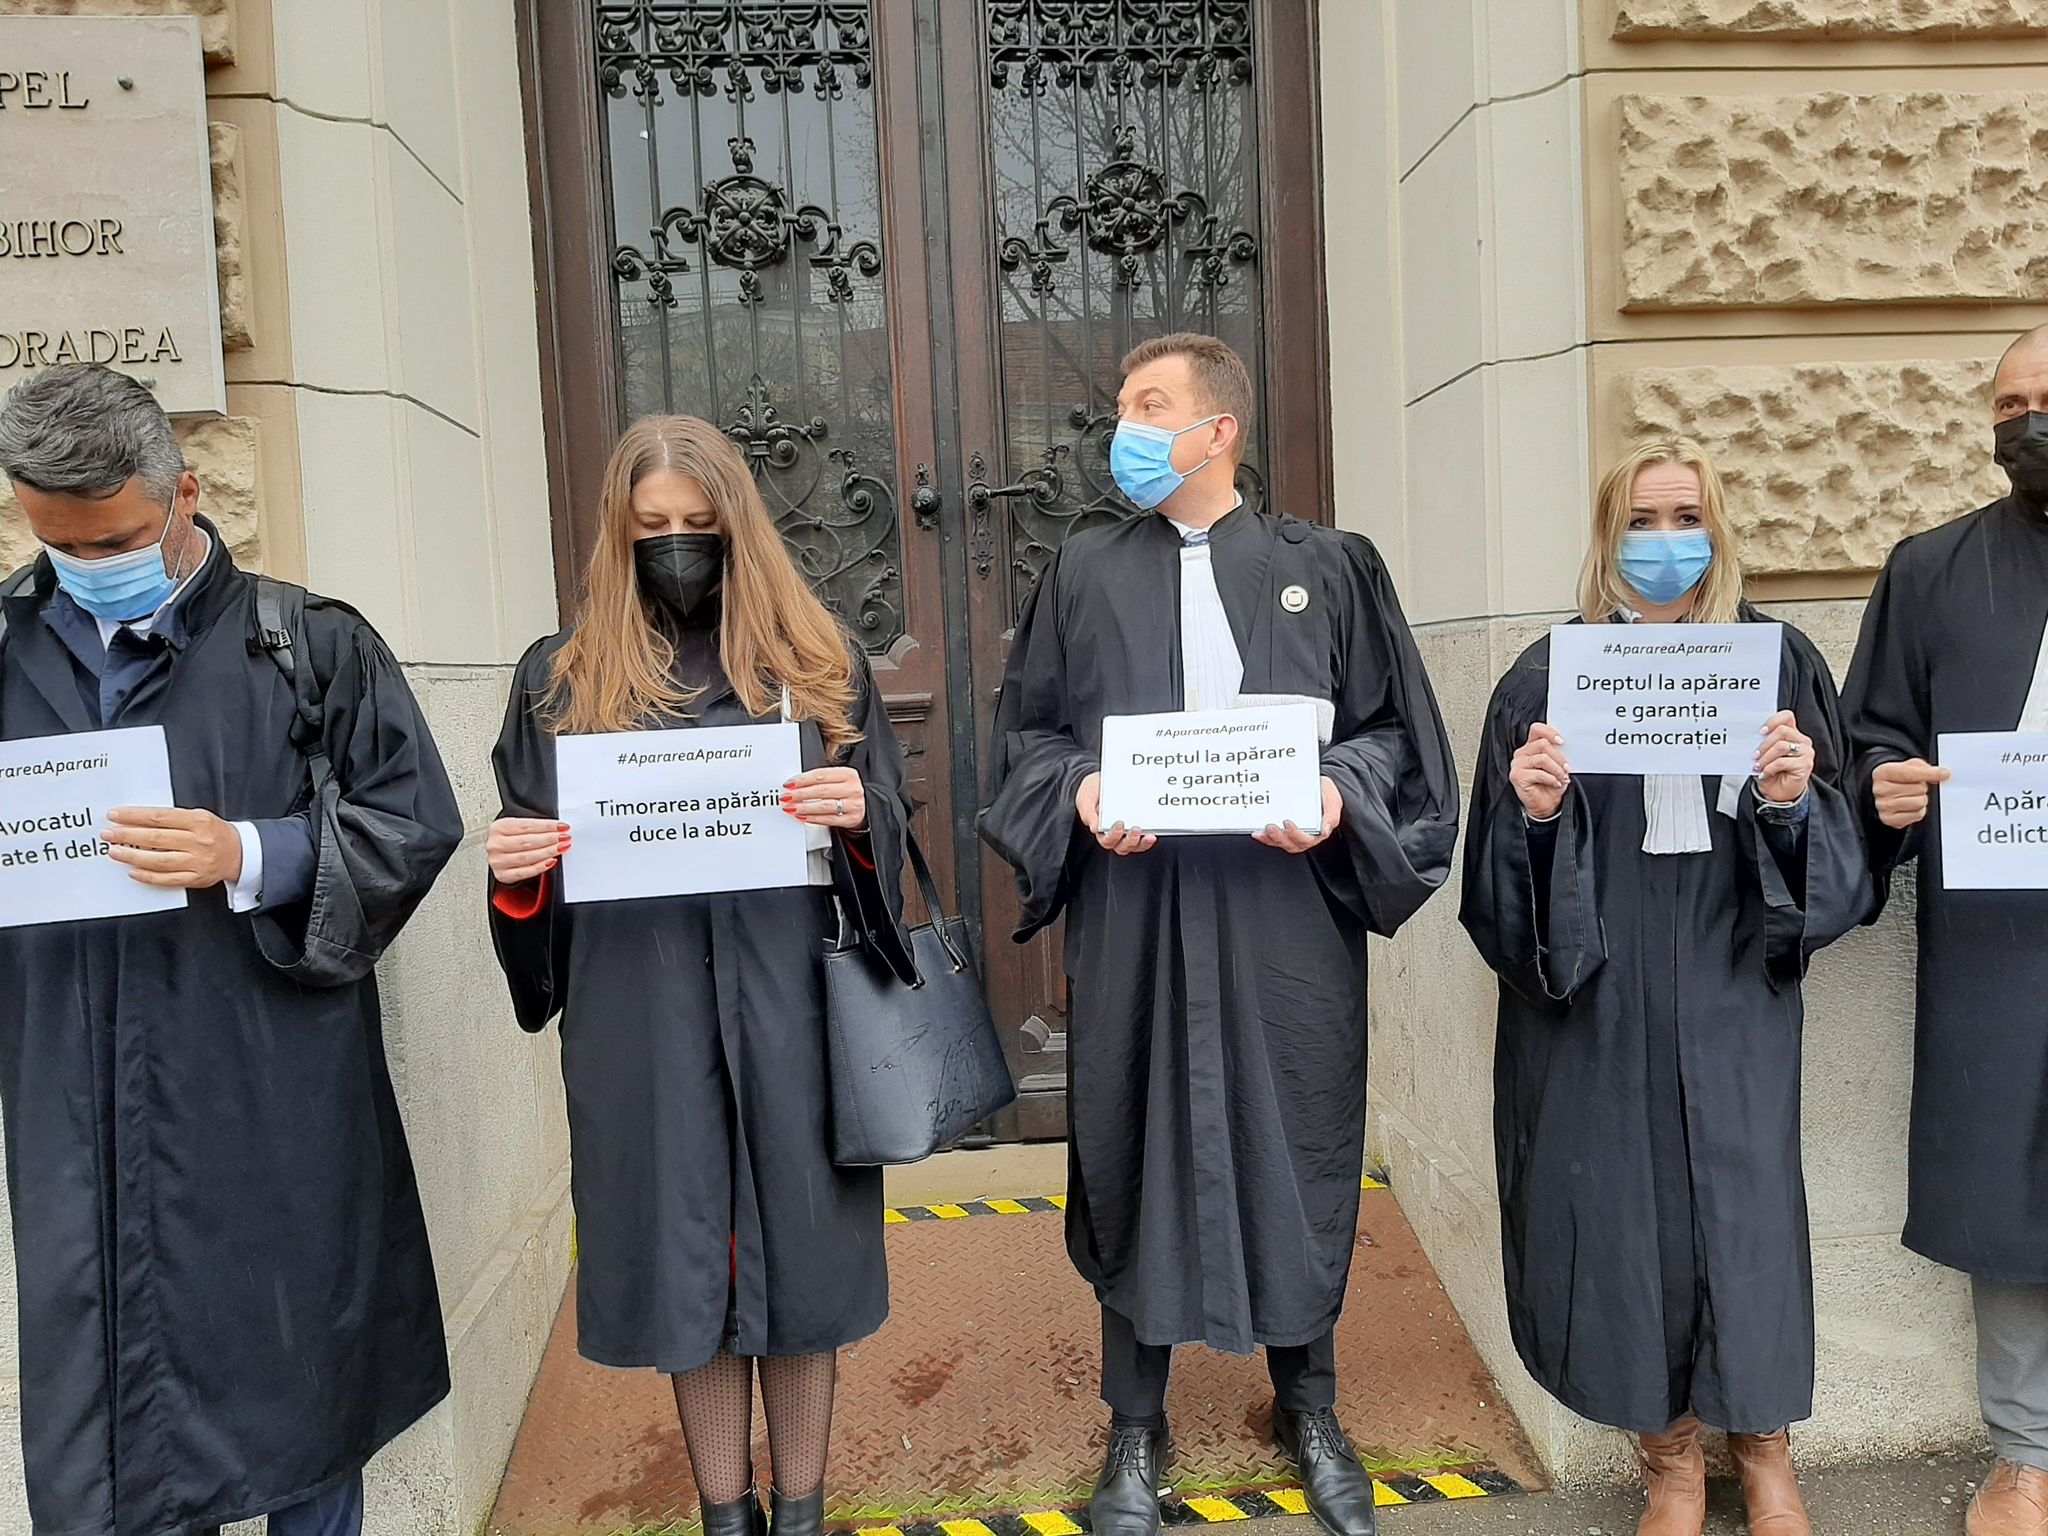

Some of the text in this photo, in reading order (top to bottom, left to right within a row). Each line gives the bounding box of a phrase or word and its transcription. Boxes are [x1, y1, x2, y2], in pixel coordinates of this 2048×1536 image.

[1603, 641, 1733, 658] #AparareaApararii
[1576, 673, 1761, 696] Dreptul la apărare
[1615, 700, 1718, 723] e garanția
[1605, 727, 1727, 750] democrației
[617, 744, 753, 768] #AparareaApararii
[1132, 746, 1296, 769] Dreptul la apărare
[1167, 768, 1260, 789] e garanția
[594, 789, 780, 817] Timorarea apărării
[1157, 790, 1270, 809] democrației
[1983, 790, 2048, 817] Apăr
[629, 819, 753, 843] duce la abuz
[1, 849, 39, 867] ate
[42, 841, 59, 862] fi
